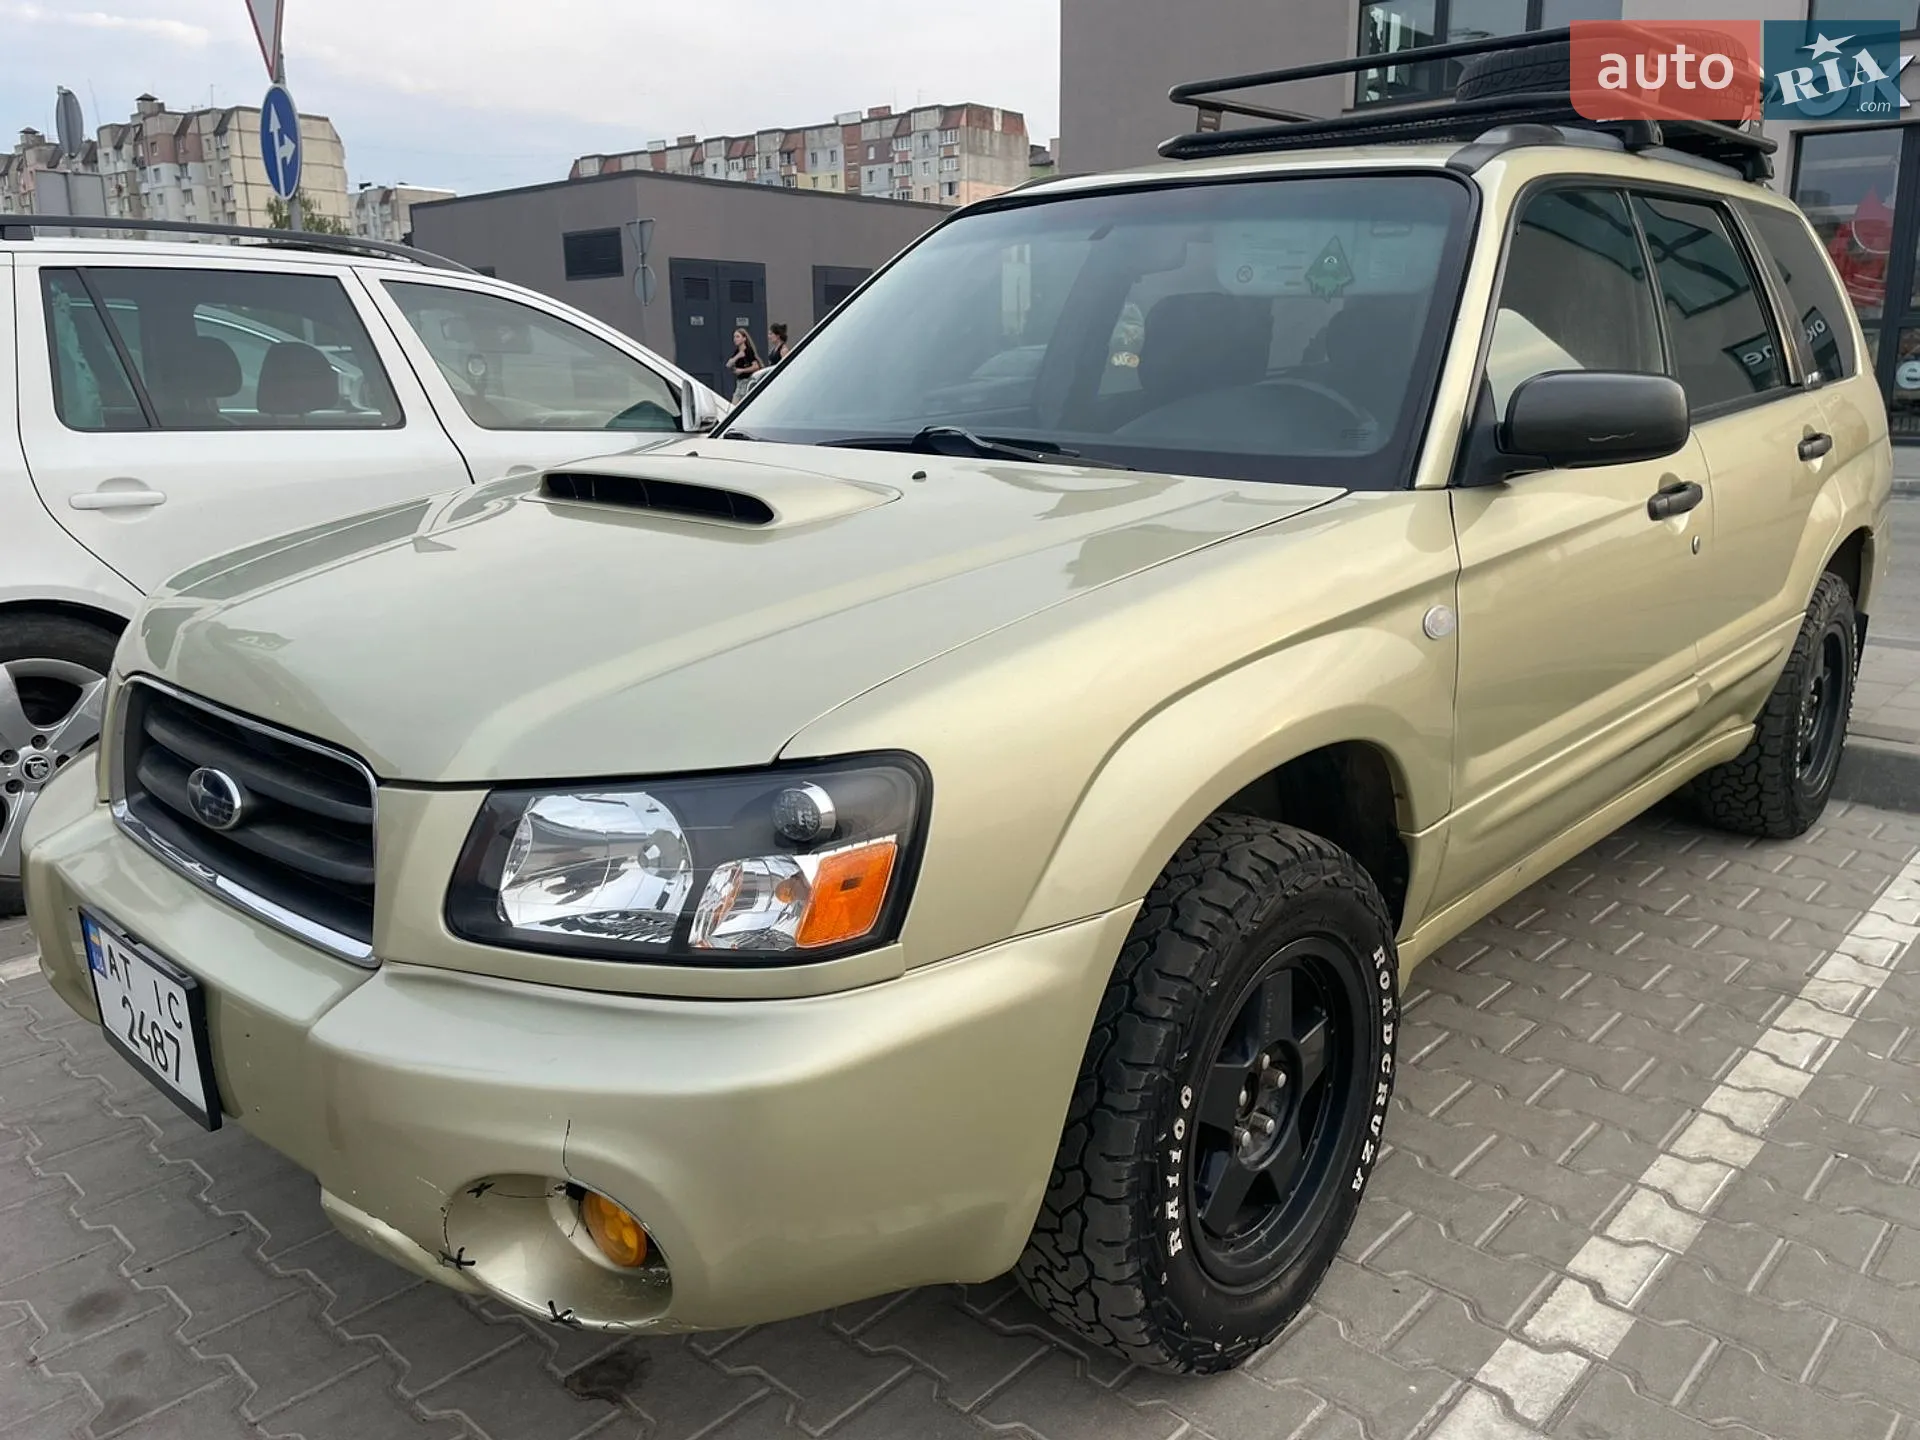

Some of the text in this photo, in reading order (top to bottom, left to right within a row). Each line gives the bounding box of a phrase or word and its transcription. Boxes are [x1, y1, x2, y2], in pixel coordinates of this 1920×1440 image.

[107, 944, 132, 990] AT
[153, 979, 183, 1030] IC
[121, 995, 181, 1083] 2487
[1351, 944, 1394, 1192] ROADCRUZA
